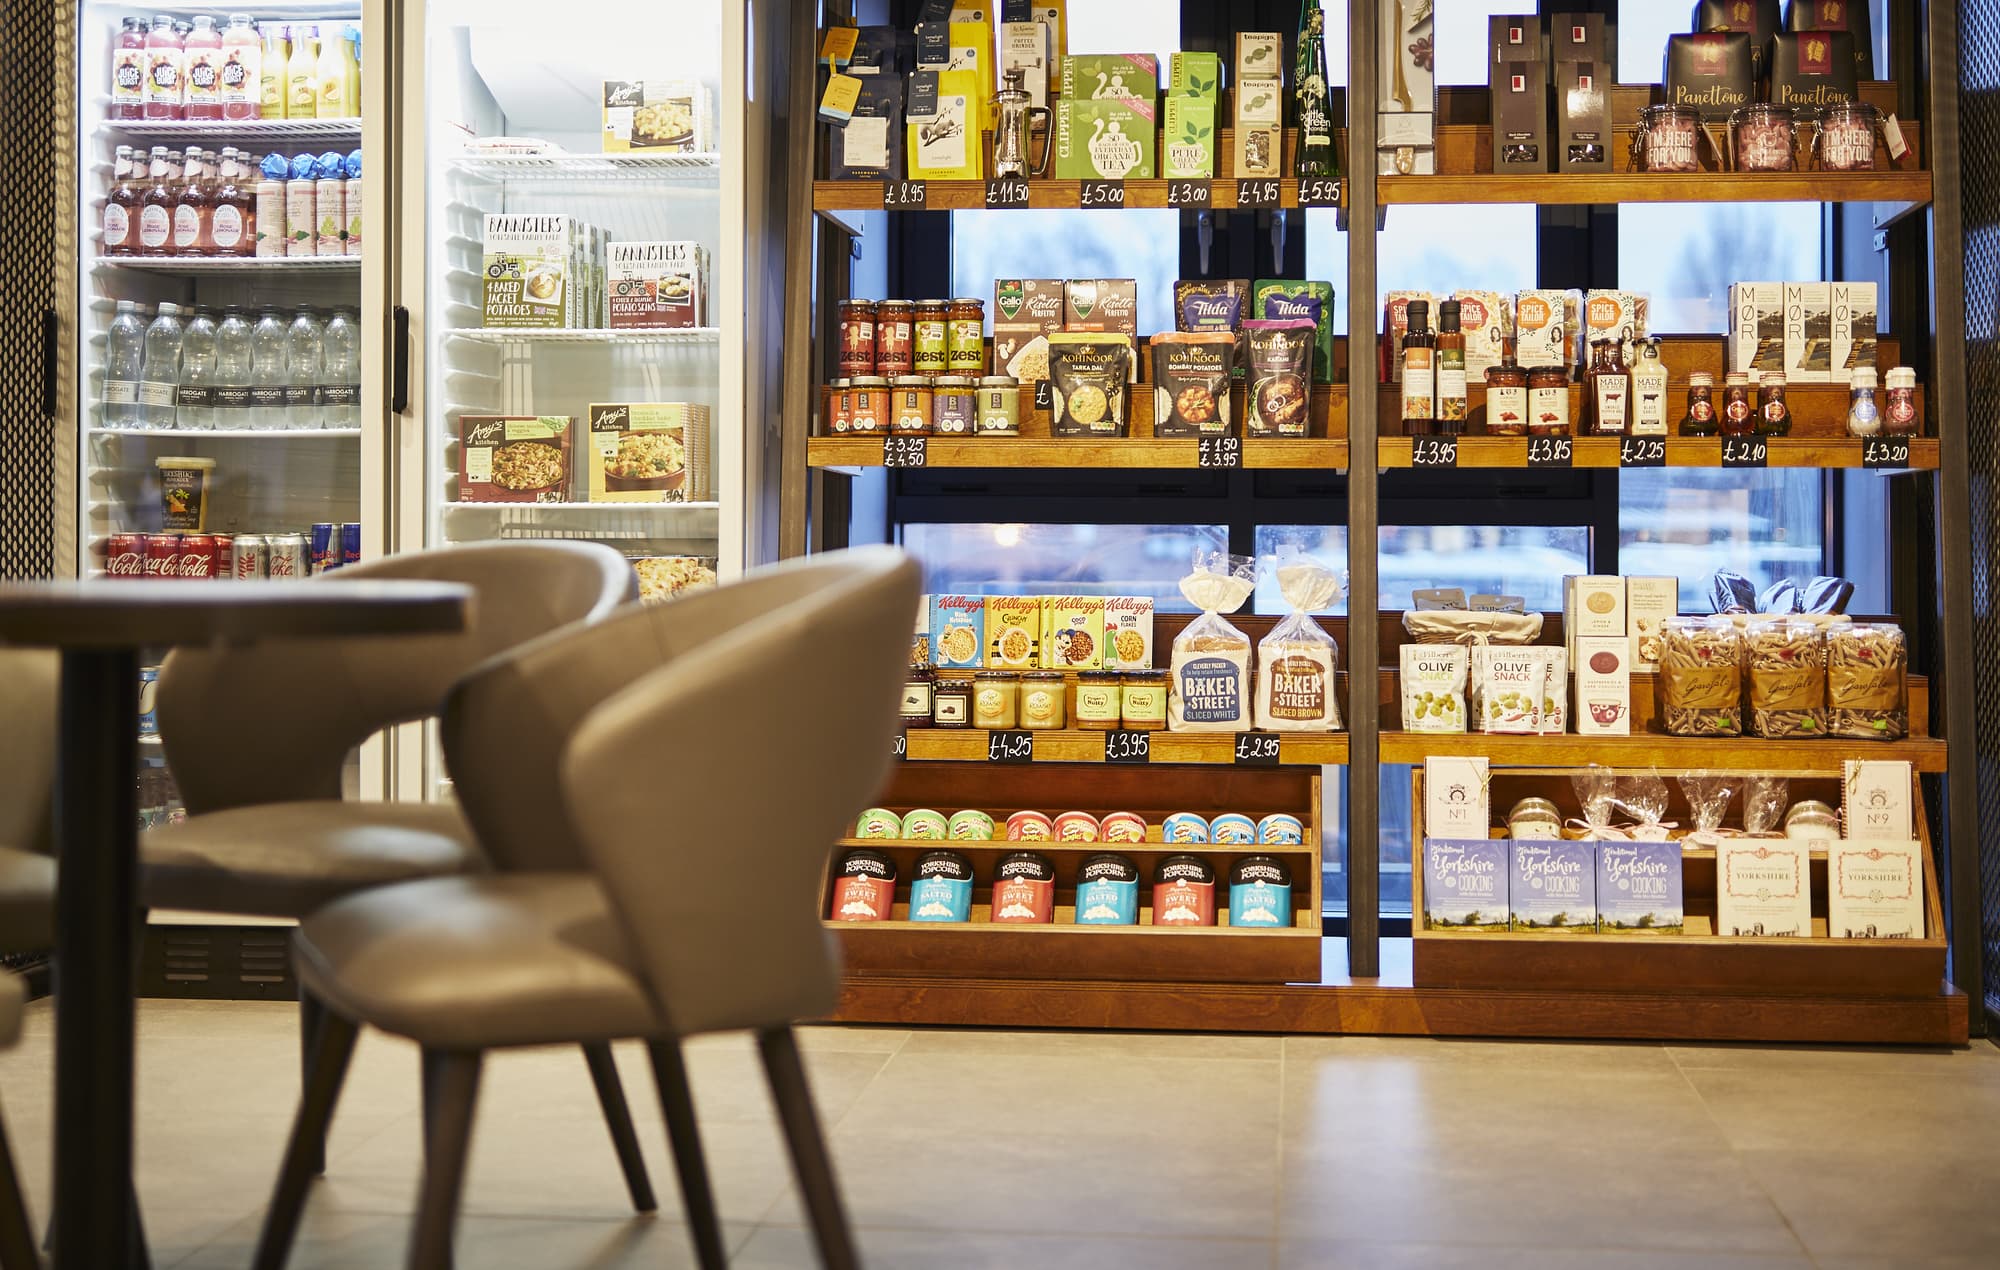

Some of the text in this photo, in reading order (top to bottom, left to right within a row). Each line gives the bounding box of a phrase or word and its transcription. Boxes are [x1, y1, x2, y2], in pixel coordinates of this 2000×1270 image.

[1676, 84, 1748, 105] Panettone
[1781, 84, 1851, 105] Panettone
[1059, 103, 1069, 157] CLIPPER
[1666, 132, 1692, 147] HERE
[1846, 131, 1871, 146] HERE
[1103, 161, 1125, 170] TEA
[490, 217, 561, 232] BANNISTERS
[615, 245, 686, 260] BANNISTERS
[487, 282, 520, 292] 4 BAKED
[488, 293, 517, 304] JACKET
[1000, 297, 1021, 306] Gallo
[1026, 297, 1063, 310] Risotto
[1072, 297, 1094, 305] Gallo
[1099, 297, 1136, 309] Risotto
[487, 305, 530, 315] POTATOES
[613, 303, 656, 312] POTATO SKINS
[1198, 303, 1228, 315] Tilda
[1279, 303, 1309, 315] Tilda
[1521, 304, 1544, 313] SPICE
[1592, 304, 1615, 312] SPICE
[1521, 312, 1544, 321] TAILOR
[1592, 312, 1615, 320] TAILOR
[840, 350, 871, 363] zest
[877, 350, 907, 363] zest
[915, 350, 945, 362] zest
[951, 349, 981, 361] zest
[1062, 354, 1112, 362] KOHINOOR
[1170, 353, 1221, 362] KOHINOOR
[597, 408, 627, 428] Amy's
[468, 421, 503, 443] Amy's
[1414, 440, 1458, 464] £3.95
[1528, 439, 1572, 462] £3.85
[1621, 440, 1665, 462] £2.25
[1723, 440, 1766, 462] £2.10
[1864, 442, 1908, 462] £3.20
[939, 596, 985, 613] Kellogg's
[992, 597, 1040, 614] Kellogg's
[1055, 597, 1104, 614] Kellogg's
[1106, 597, 1153, 615] Kellogg's
[1002, 614, 1027, 623] CRUNCHY
[1418, 662, 1454, 672] OLIVE
[1494, 662, 1531, 672] OLIVE
[1419, 672, 1453, 680] SNACK
[1494, 672, 1530, 681] SNACK
[1186, 677, 1236, 696] BAKER
[1275, 673, 1321, 693] BAKER
[1192, 696, 1230, 709] STREET
[1279, 694, 1316, 707] STREET
[1187, 710, 1236, 719] SLICED WHITE
[1272, 706, 1322, 717] SLICED BROWN
[989, 731, 1033, 760] £4.25
[1106, 734, 1149, 758] £3.95
[1236, 736, 1280, 759] £2.95
[846, 860, 885, 870] YORKSHIRE
[846, 865, 884, 875] POPCORN
[921, 860, 960, 870] YORKSHIRE
[921, 866, 960, 875] POPCORN
[1002, 862, 1042, 871] YORKSHIRE
[1086, 863, 1124, 872] YORKSHIRE
[1163, 864, 1202, 873] YORKSHIRE
[1241, 865, 1280, 875] YORKSHIRE
[1432, 853, 1494, 881] Yorkshire
[1518, 854, 1581, 881] Yorkshire
[1605, 855, 1668, 882] Yorkshire
[1002, 868, 1041, 876] POPCORN
[1086, 870, 1125, 878] POPCORN
[1736, 872, 1791, 881] YORKSHIRE
[1848, 873, 1904, 882] YORKSHIRE
[1458, 876, 1493, 893] COOKING
[1545, 876, 1580, 893] COOKING
[1632, 876, 1667, 894] COOKING
